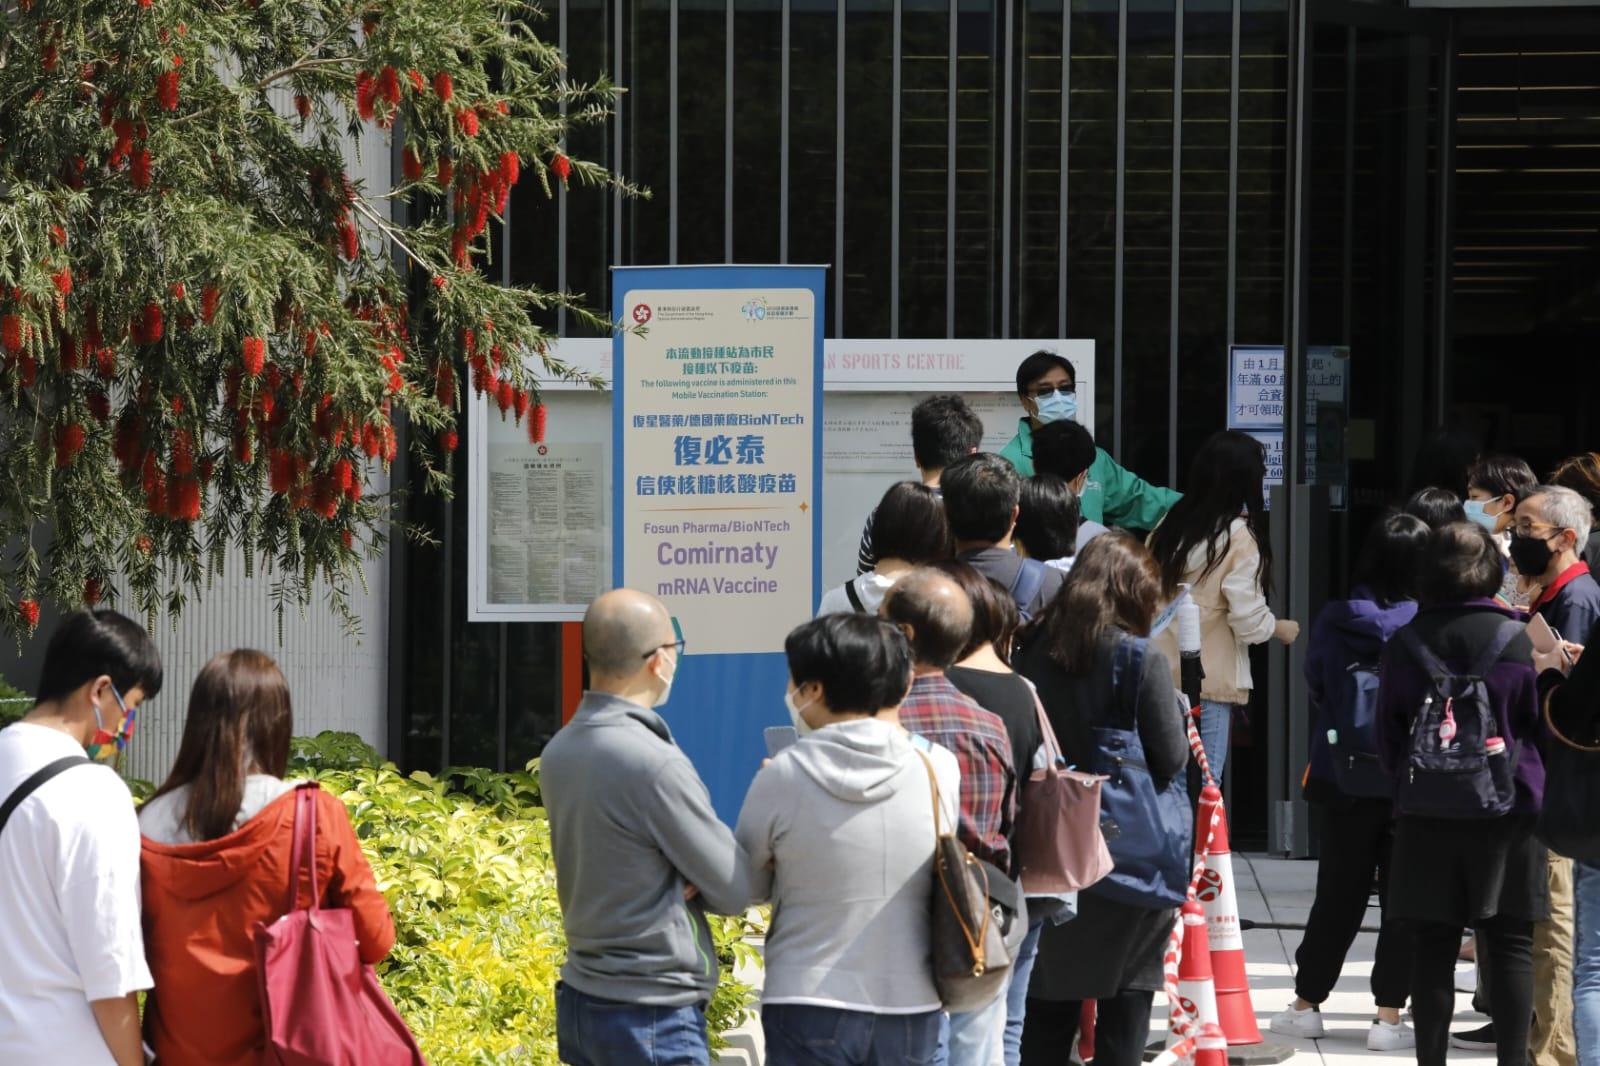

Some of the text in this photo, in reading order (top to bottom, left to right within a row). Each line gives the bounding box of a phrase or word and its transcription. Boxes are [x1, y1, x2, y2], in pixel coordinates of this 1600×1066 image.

[665, 346, 774, 360] 本流動接種站為市民
[682, 361, 759, 375] 接種以下疫苗:
[842, 353, 901, 369] SPORTS
[907, 353, 966, 369] CENTRE
[641, 377, 797, 391] The following vaccine is administered in this
[1238, 374, 1261, 386] 年滿
[1264, 375, 1276, 384] 60
[672, 390, 769, 400] Mobile Vaccination Station:
[632, 413, 805, 428] 復星醫藥/德國藥廠BioNTech
[673, 434, 766, 466] 復必泰
[636, 473, 797, 496] 信使核糖核酸疫苗
[643, 520, 791, 534] Fosun Pharma/BioNTech
[657, 541, 779, 570] Comirnaty
[657, 577, 778, 596] mRNA Vaccine
